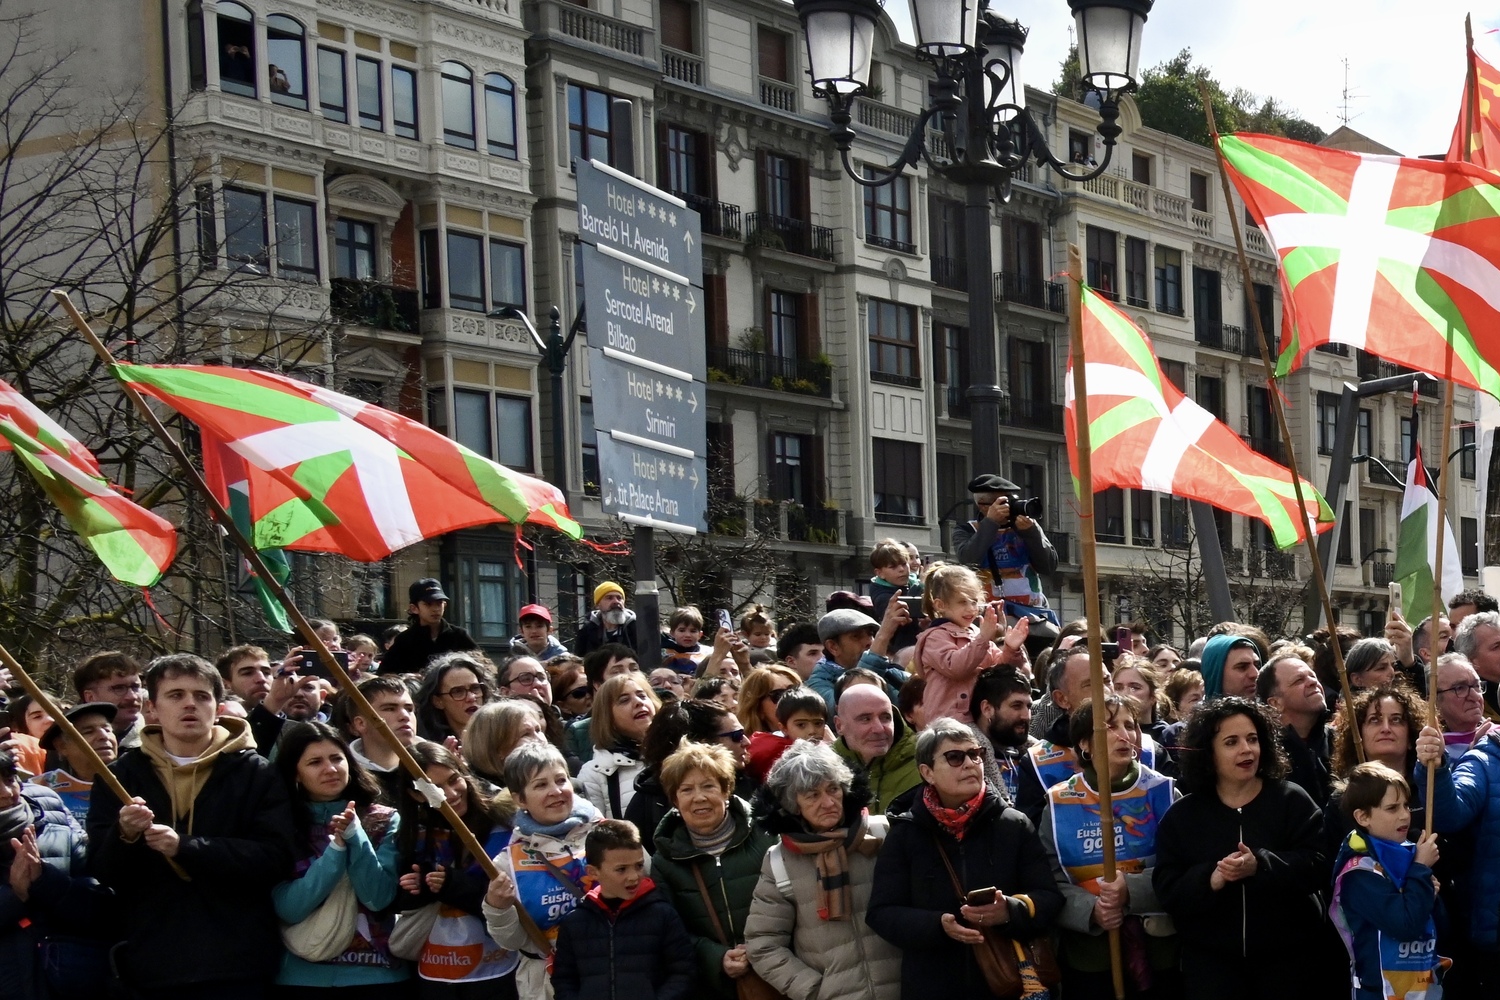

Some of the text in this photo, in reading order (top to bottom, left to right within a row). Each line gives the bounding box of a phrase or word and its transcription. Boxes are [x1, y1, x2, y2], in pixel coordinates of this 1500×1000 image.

[607, 182, 636, 218] Hotel
[581, 204, 619, 242] Barceló
[622, 265, 650, 298] Hotel
[605, 288, 674, 336] Sercotel Arenal
[607, 320, 636, 354] Bilbao
[627, 371, 654, 402] Hotel
[645, 408, 676, 439] Sirimiri
[632, 452, 658, 481] Hotel
[629, 482, 655, 512] Palace
[655, 489, 679, 517] Arana
[1083, 834, 1124, 853] gaa
[1398, 938, 1436, 959] gara
